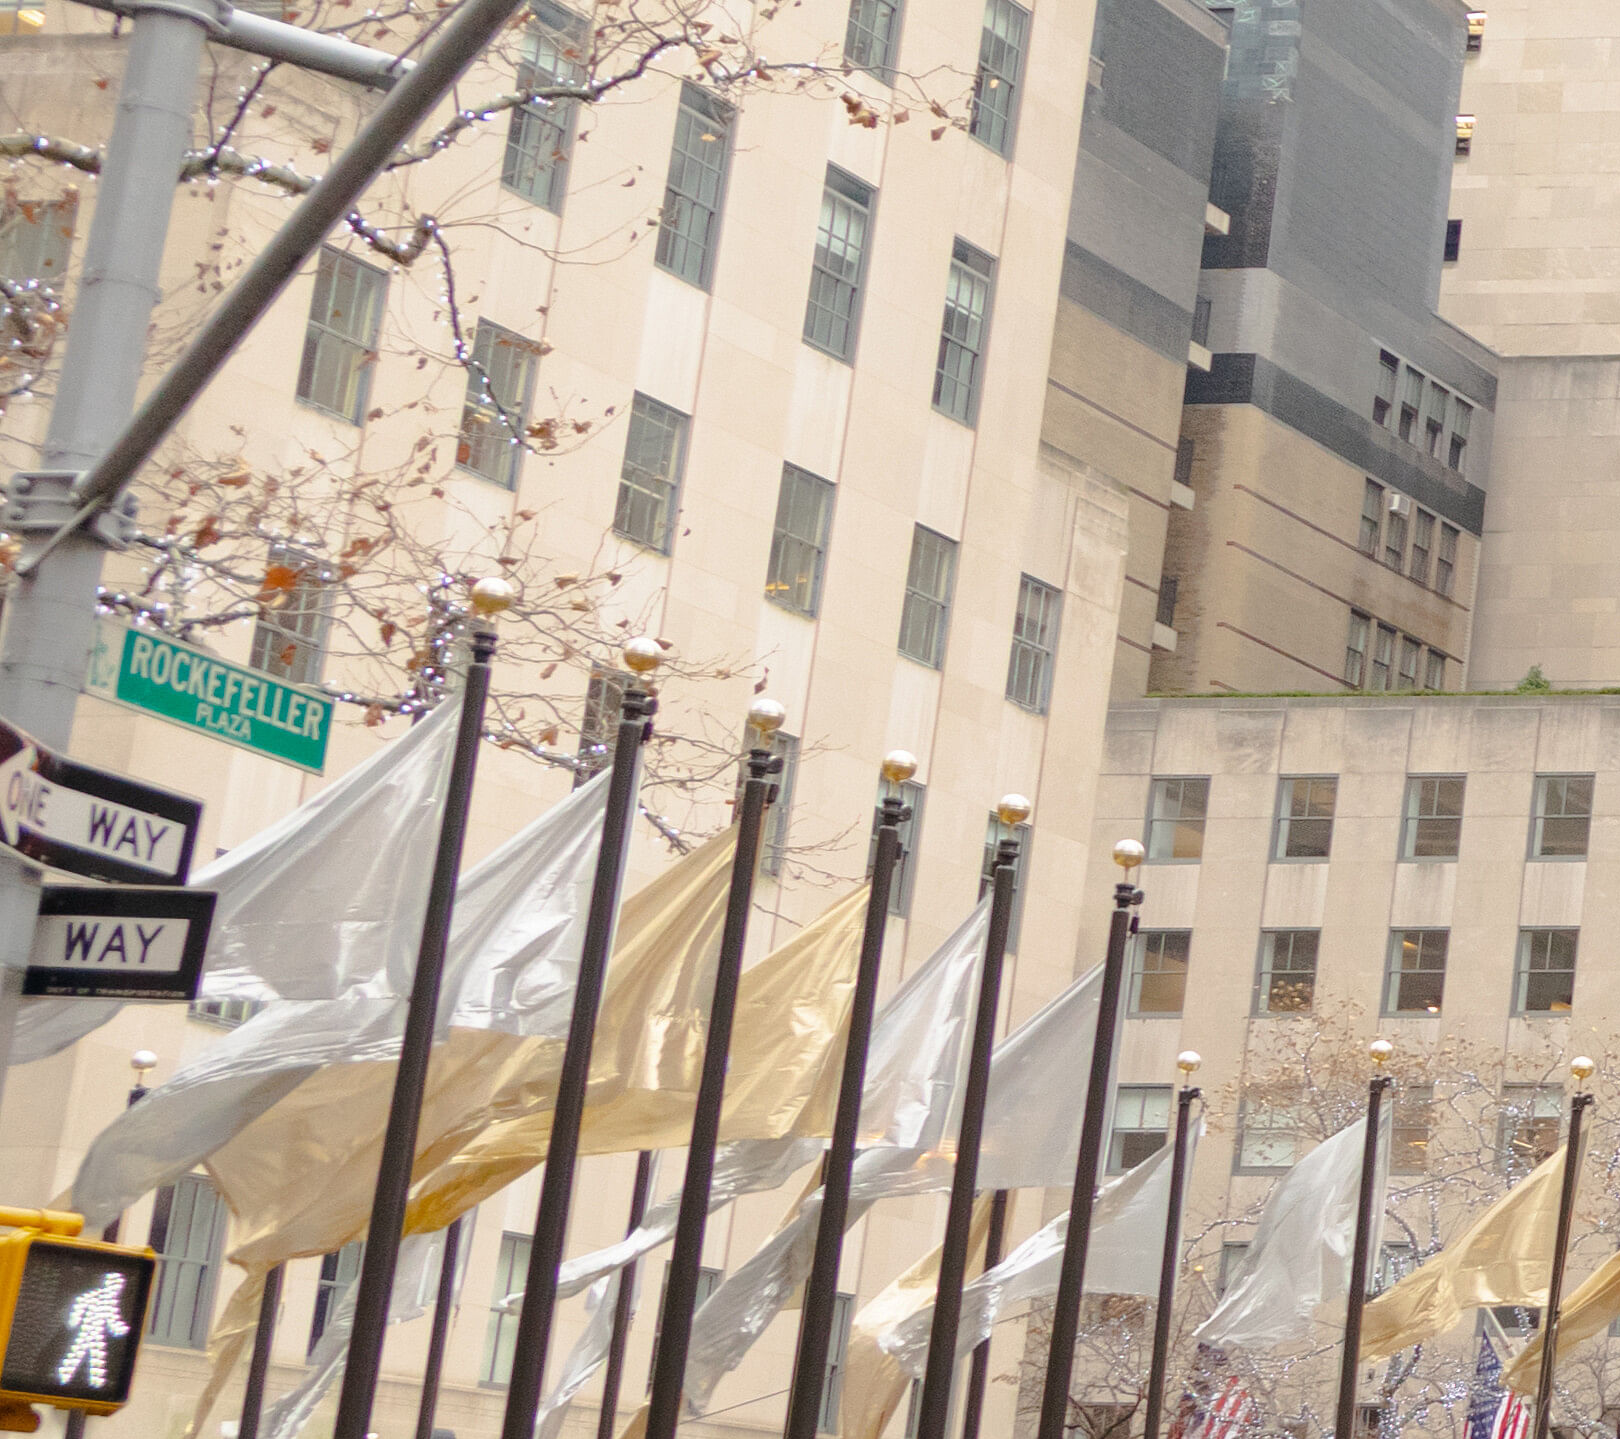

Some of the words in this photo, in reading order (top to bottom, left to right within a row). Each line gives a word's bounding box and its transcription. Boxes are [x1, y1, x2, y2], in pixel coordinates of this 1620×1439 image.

[129, 635, 324, 740] ROCKEFELLER
[195, 702, 251, 740] PLAZA
[89, 803, 169, 861] WAY
[65, 921, 165, 963] WAY
